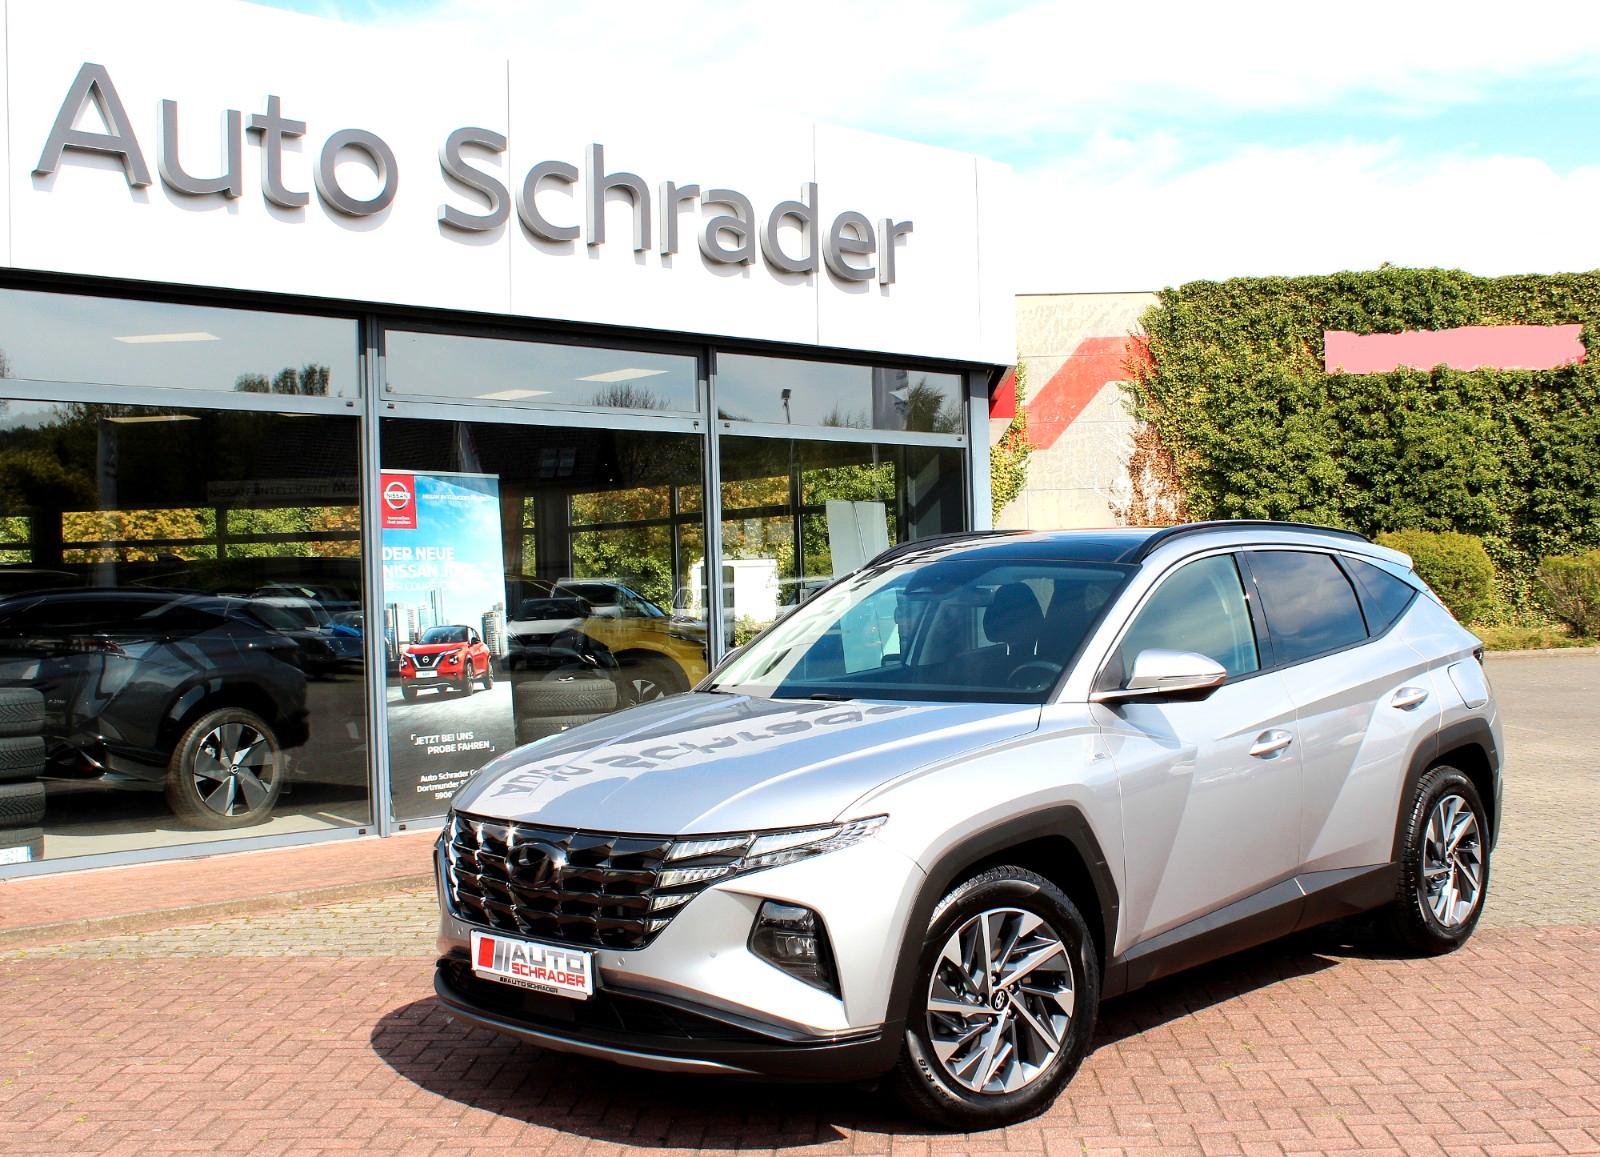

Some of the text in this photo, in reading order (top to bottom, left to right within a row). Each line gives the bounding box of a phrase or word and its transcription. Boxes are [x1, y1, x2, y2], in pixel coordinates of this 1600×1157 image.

[31, 62, 913, 286] Auto Schrader
[382, 547, 455, 561] DER NEUE
[383, 564, 437, 578] NISSAN
[441, 733, 455, 742] BEI
[456, 731, 474, 741] UNS
[427, 740, 490, 755] PROBE FAHREN
[420, 774, 438, 782] Auto
[438, 769, 470, 780] Schrader
[434, 790, 456, 800] 5906
[511, 943, 585, 975] AUTO
[511, 962, 586, 988] SCHRADER
